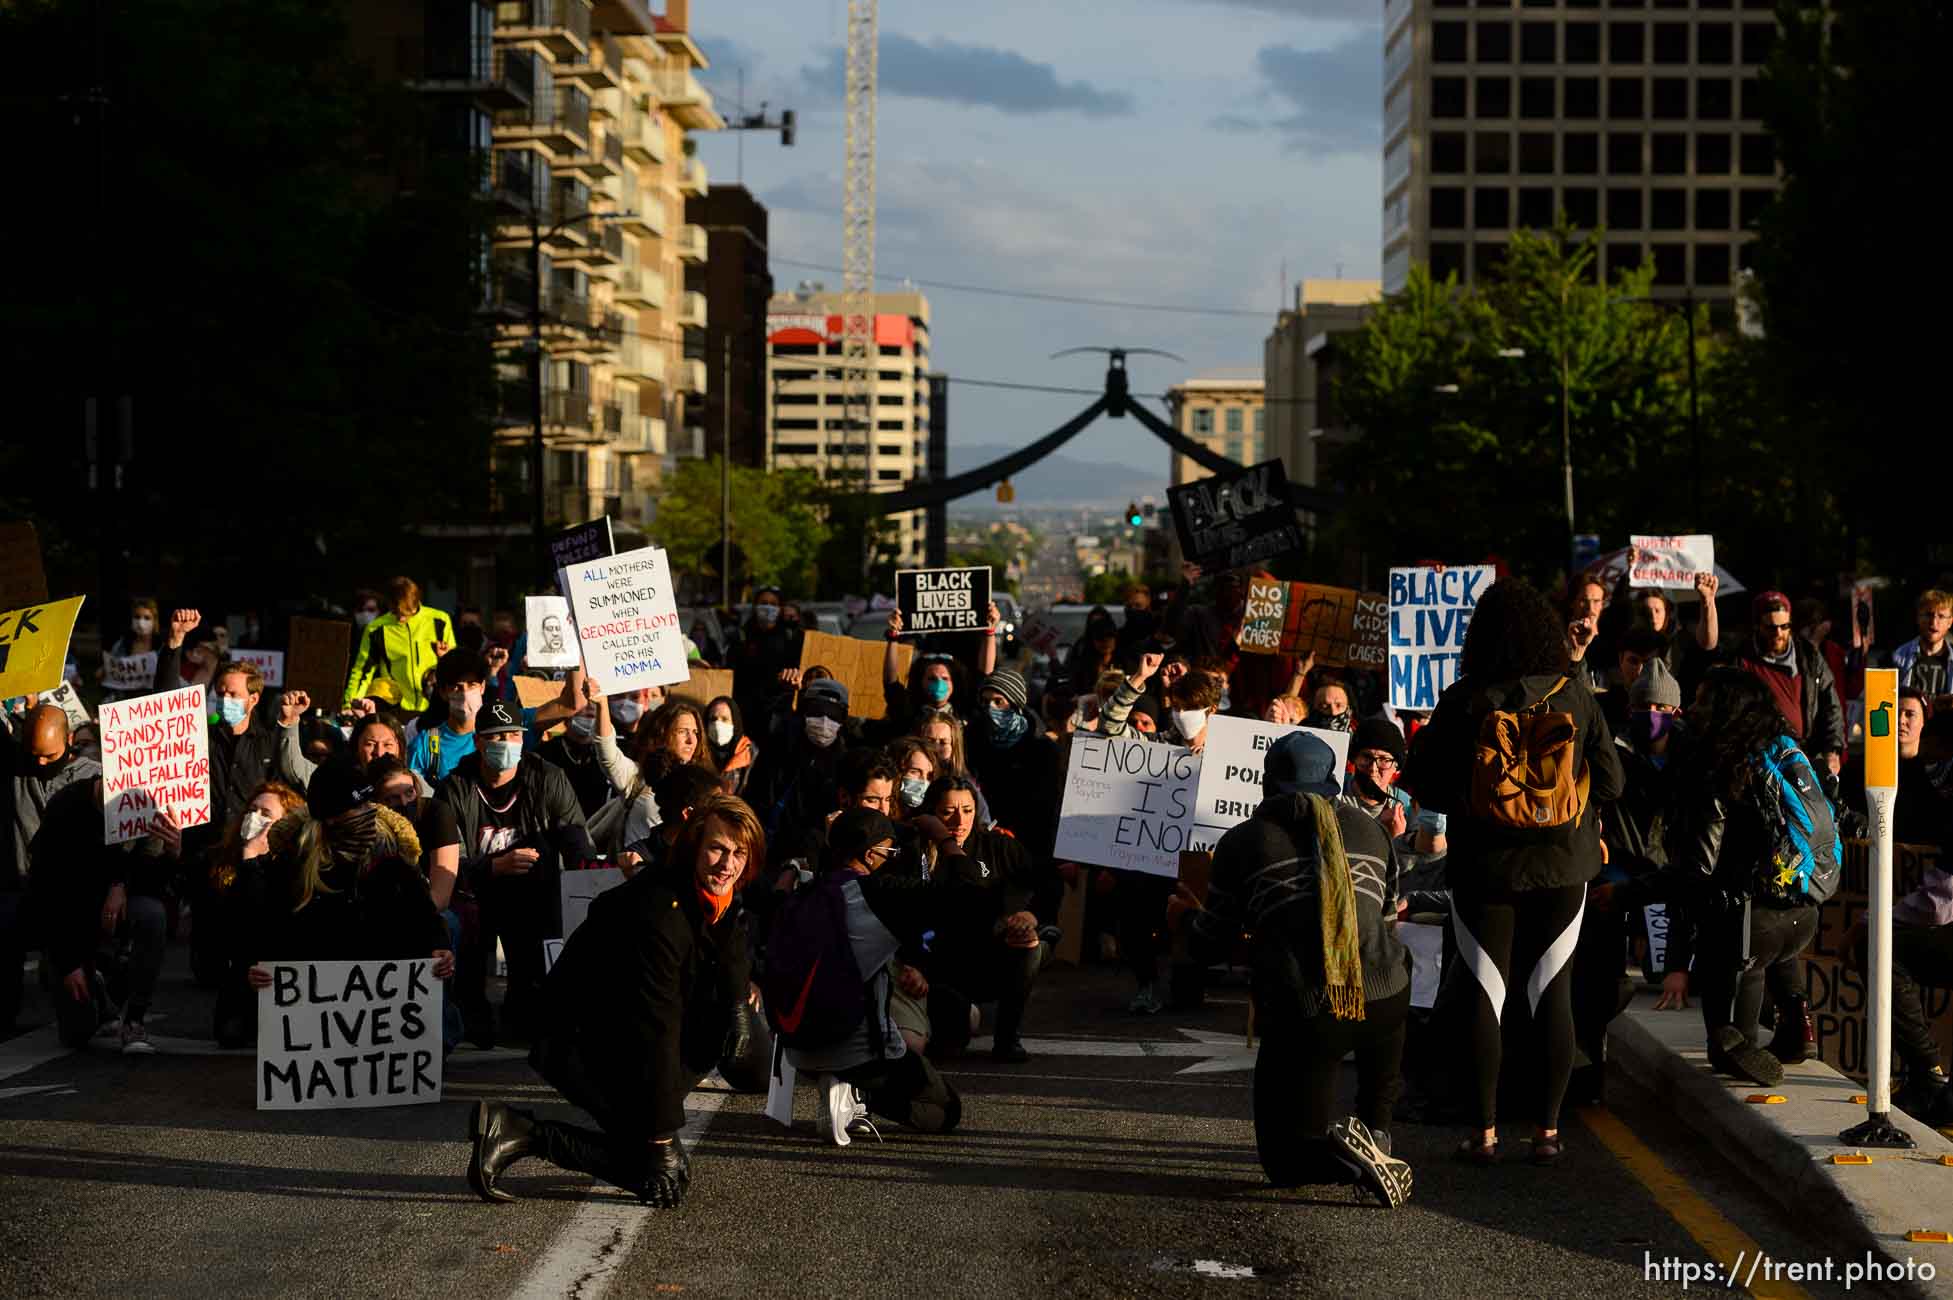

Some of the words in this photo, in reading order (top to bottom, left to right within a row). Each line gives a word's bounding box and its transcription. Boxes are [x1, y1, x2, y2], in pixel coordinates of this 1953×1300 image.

[583, 567, 608, 582] ALL
[608, 560, 655, 576] MOTHERS
[916, 571, 973, 591] BLACK
[606, 576, 633, 590] WERE
[1250, 584, 1282, 601] NO
[1391, 570, 1483, 607] BLACK
[589, 587, 656, 609] SUMMONED
[921, 592, 967, 608] LIVES
[1357, 599, 1389, 617] NO
[612, 607, 639, 619] WHEN
[911, 610, 978, 629] MATTER
[1255, 620, 1270, 628] IN
[580, 620, 632, 640] GEORGE
[635, 613, 678, 631] FLOYD
[1242, 626, 1280, 648] CAGES
[1391, 608, 1473, 647] LIVE
[602, 635, 639, 650] CALLED
[641, 631, 661, 644] OUT
[614, 650, 635, 662] FOR
[637, 647, 655, 658] HIS
[1348, 643, 1385, 664] CAGES
[614, 658, 662, 677] MOMMA
[128, 698, 163, 721] MAN
[167, 690, 201, 712] WHO
[104, 719, 165, 753] STANDS
[166, 713, 197, 739] FOR
[1252, 735, 1273, 751] EN
[118, 737, 195, 771] NOTHING
[1081, 735, 1193, 780] ENOUG
[106, 770, 147, 793] WILL
[149, 762, 182, 785] FALL
[185, 757, 209, 779] FOR
[1225, 765, 1264, 786] POL
[1131, 780, 1188, 819] IS
[1215, 799, 1258, 818] BRU
[1115, 816, 1192, 853] ENO
[273, 962, 429, 1007] BLACK
[282, 1002, 426, 1052] LIVES
[263, 1051, 436, 1103] MATTER
